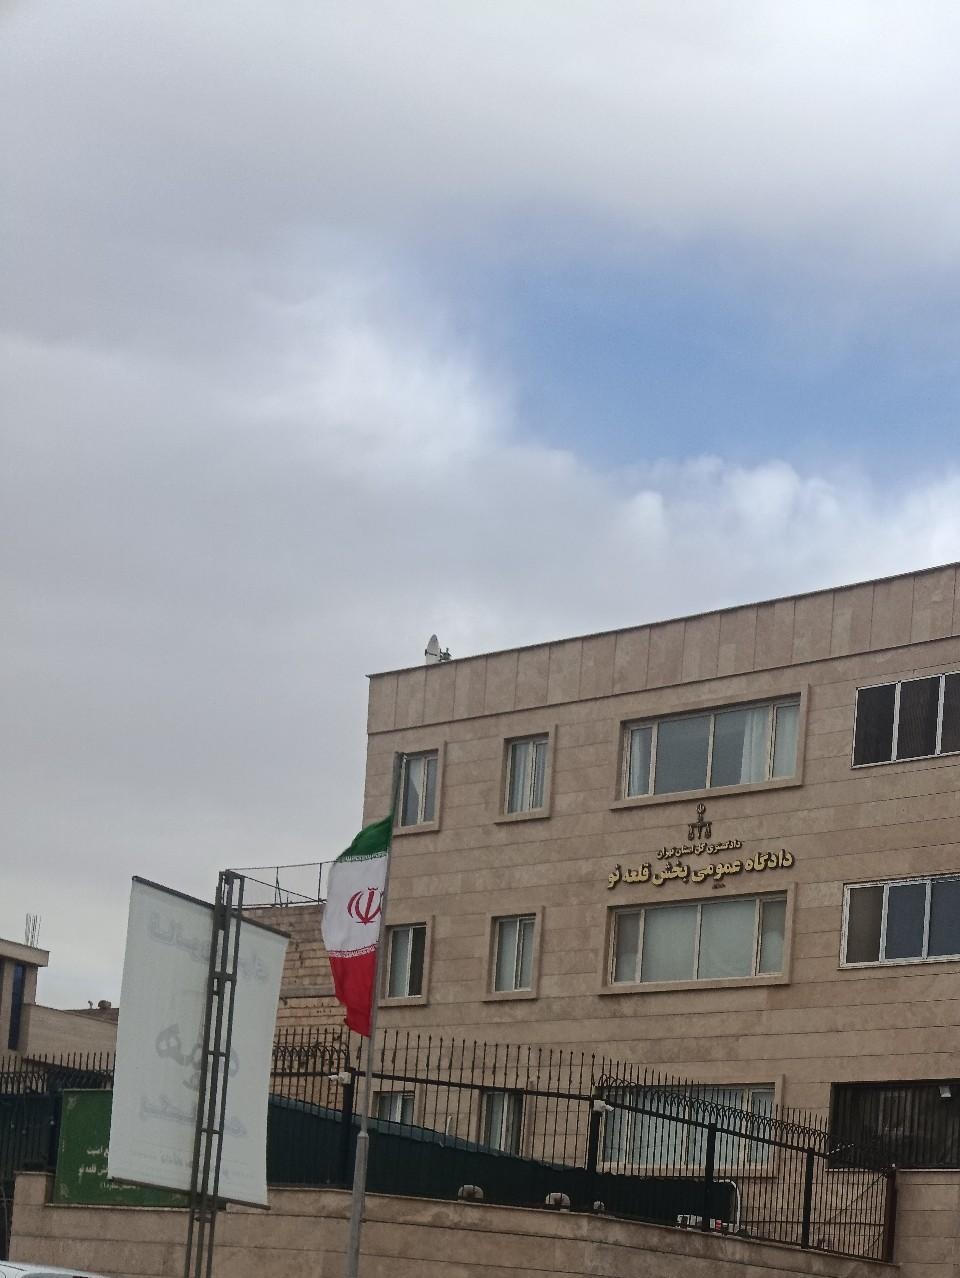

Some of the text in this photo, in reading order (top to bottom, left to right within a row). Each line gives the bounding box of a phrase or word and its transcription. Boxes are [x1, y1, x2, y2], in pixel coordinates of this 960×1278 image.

[656, 839, 742, 859] دادگستری کل استان تهران
[607, 849, 794, 889] دادگاه عمومی بخش قلعه نو
